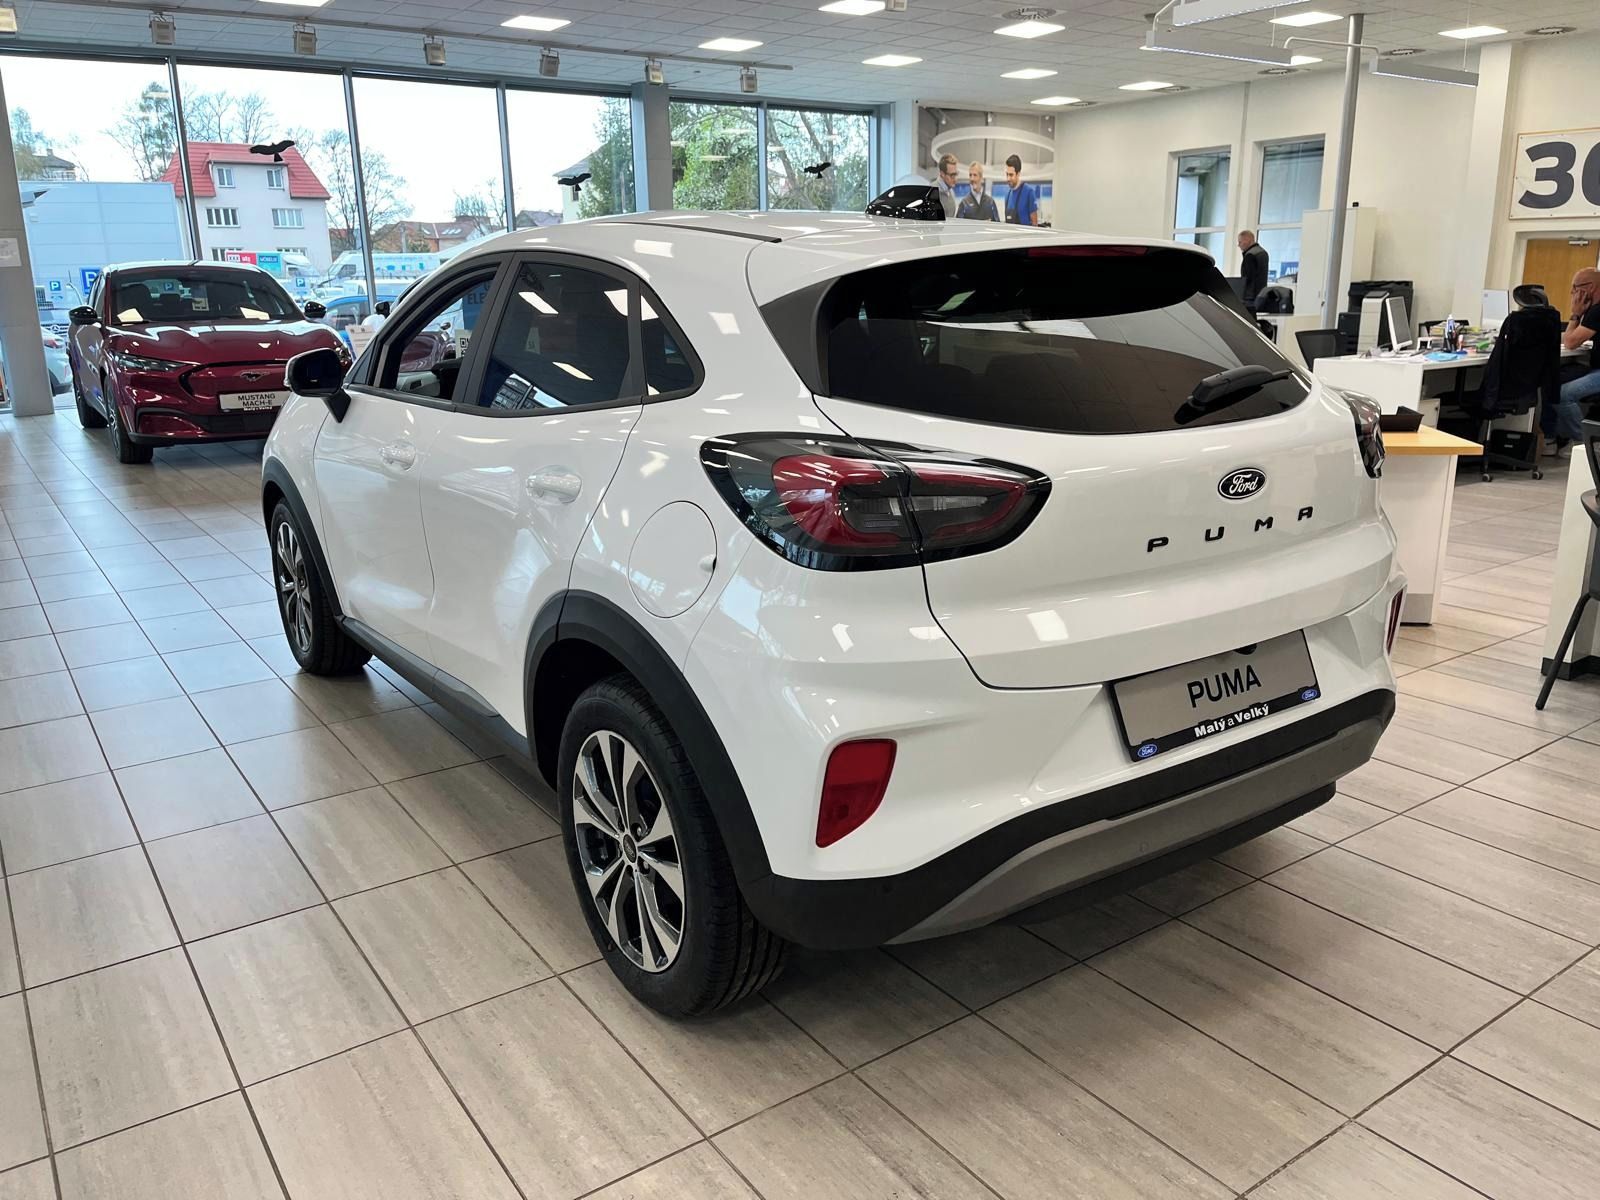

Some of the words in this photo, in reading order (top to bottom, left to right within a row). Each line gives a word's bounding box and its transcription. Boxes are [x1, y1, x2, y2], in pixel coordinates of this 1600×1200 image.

[51, 282, 59, 290] P
[85, 271, 99, 287] P
[238, 393, 276, 401] MUSTANG
[1228, 473, 1260, 495] Ford
[1147, 506, 1313, 552] PUMA
[1187, 665, 1262, 708] PUMA
[1194, 718, 1226, 738] Malý
[1227, 718, 1235, 727] a
[1234, 703, 1269, 723] Velký
